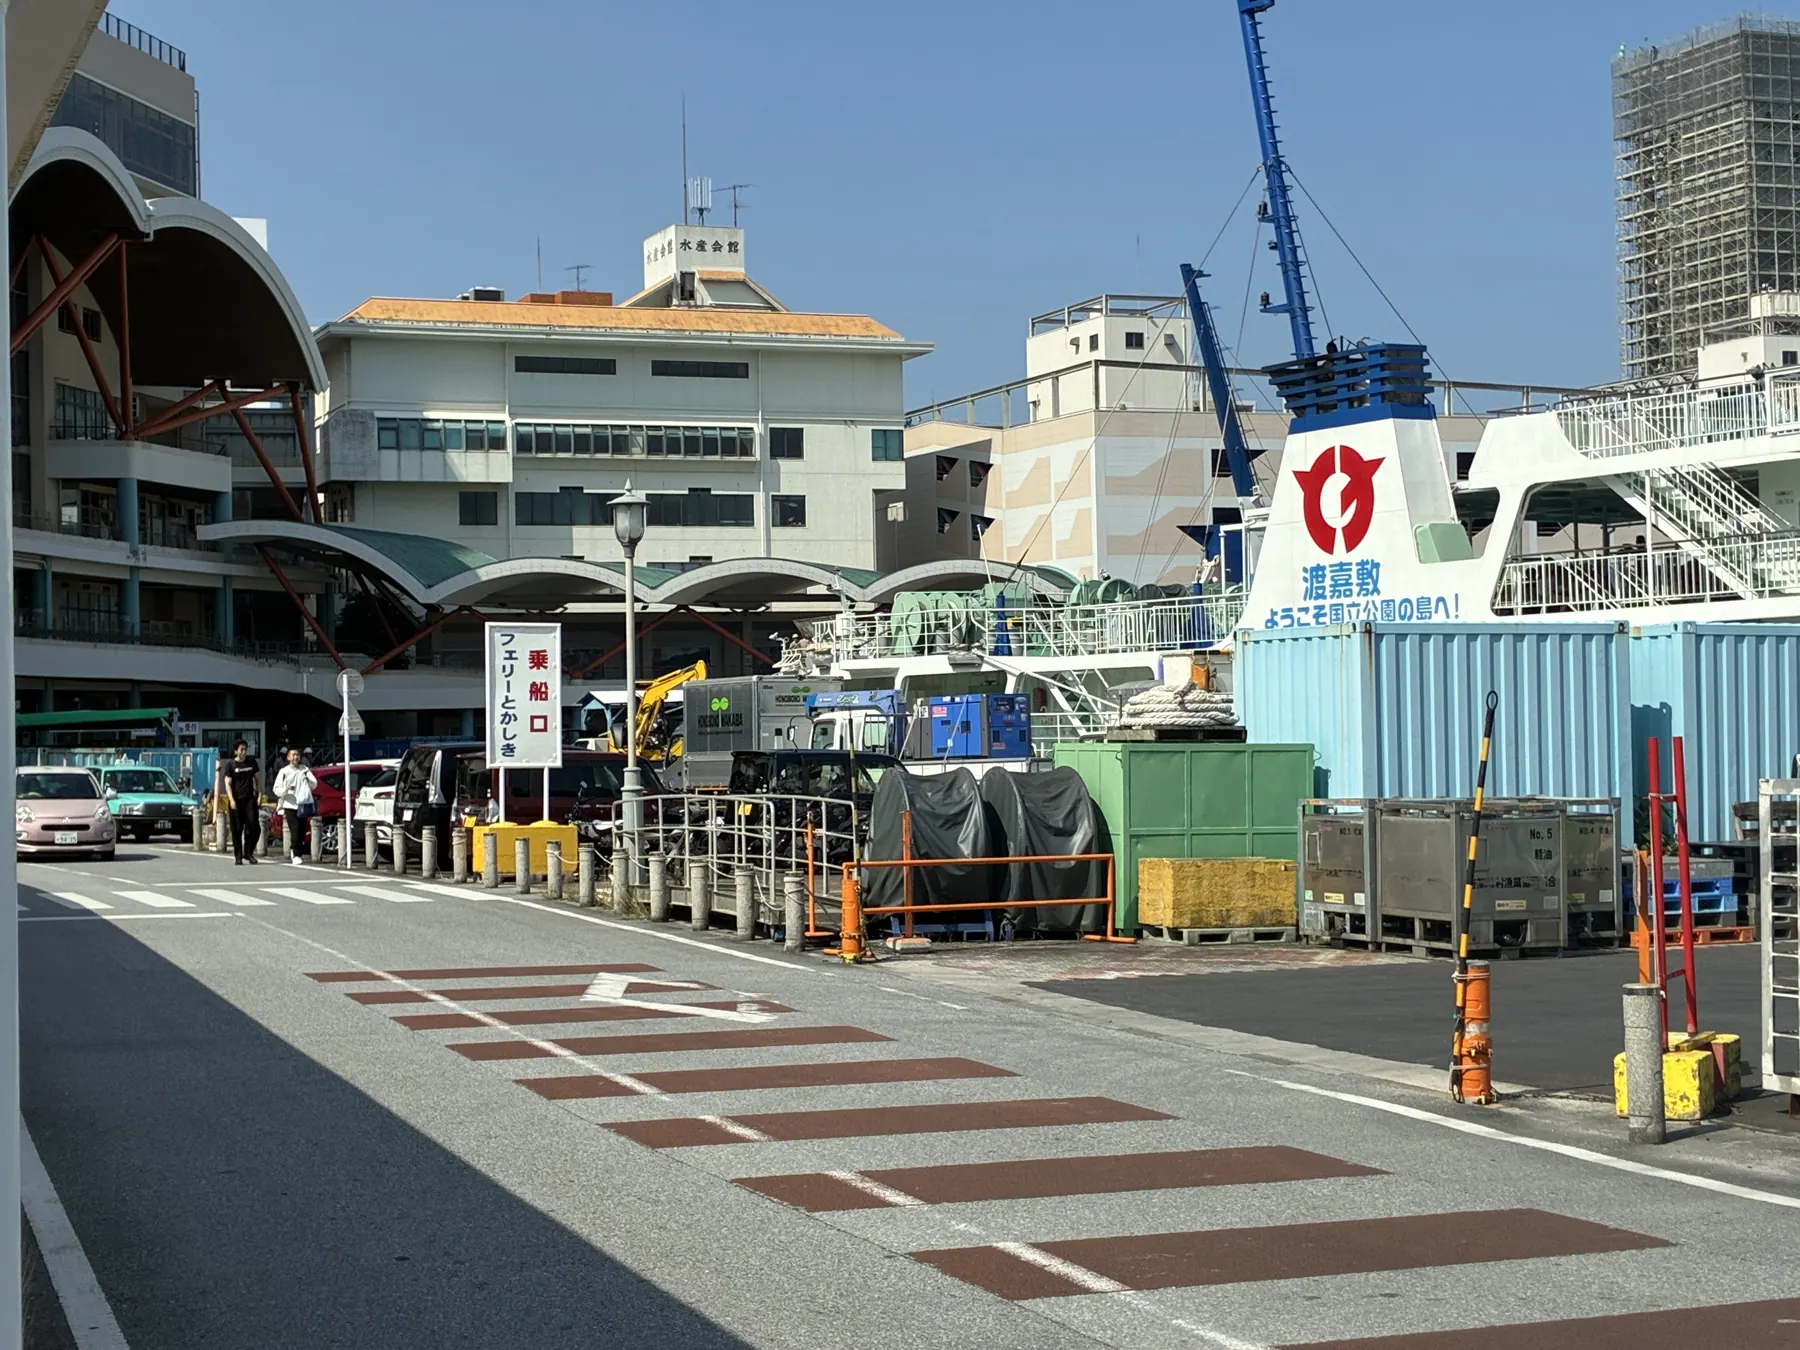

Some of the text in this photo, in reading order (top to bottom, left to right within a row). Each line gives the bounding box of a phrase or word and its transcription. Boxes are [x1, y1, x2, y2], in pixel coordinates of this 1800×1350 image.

[679, 238, 740, 254] 水産会館
[1302, 558, 1381, 602] 渡嘉敷
[499, 633, 519, 758] フェリーとかしき
[528, 649, 549, 733] 乗船口
